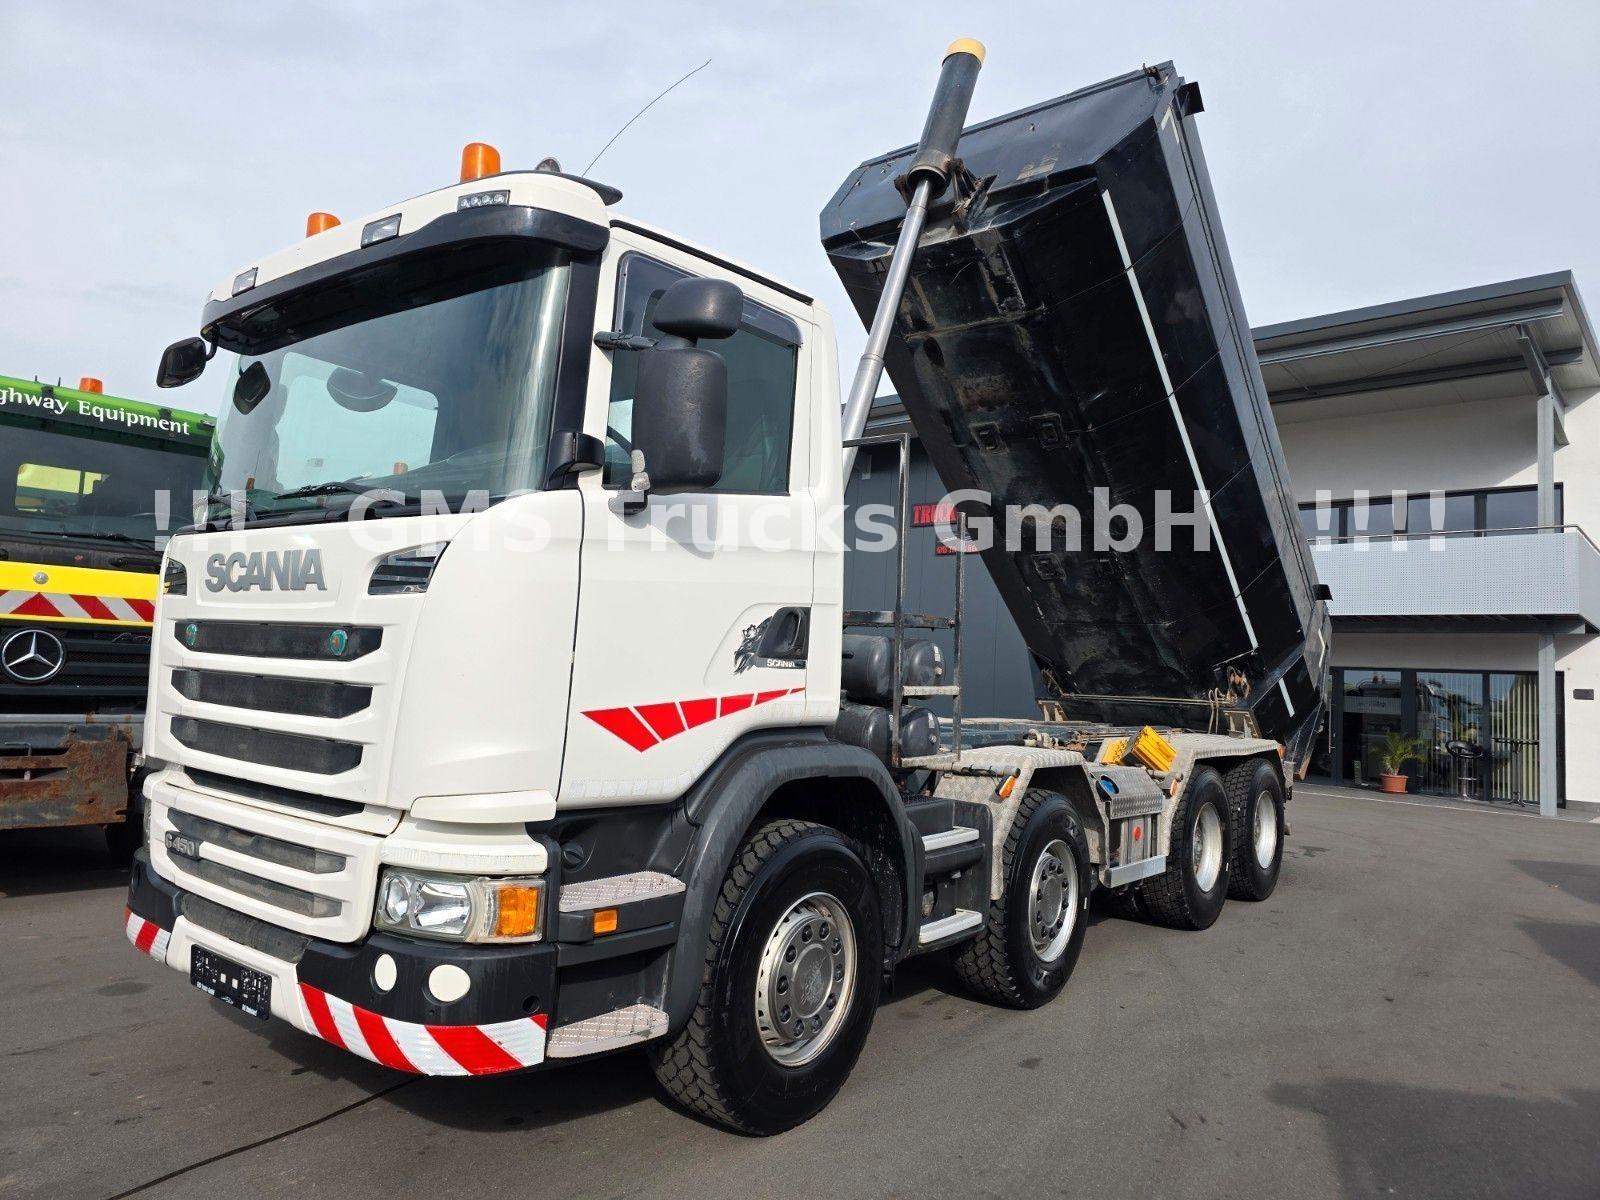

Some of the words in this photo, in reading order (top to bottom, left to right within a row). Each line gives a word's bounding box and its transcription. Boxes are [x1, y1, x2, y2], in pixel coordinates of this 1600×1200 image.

[77, 400, 190, 435] Equipment
[205, 549, 327, 592] SCANIA
[766, 659, 796, 667] SCANIA
[173, 837, 195, 856] 450
